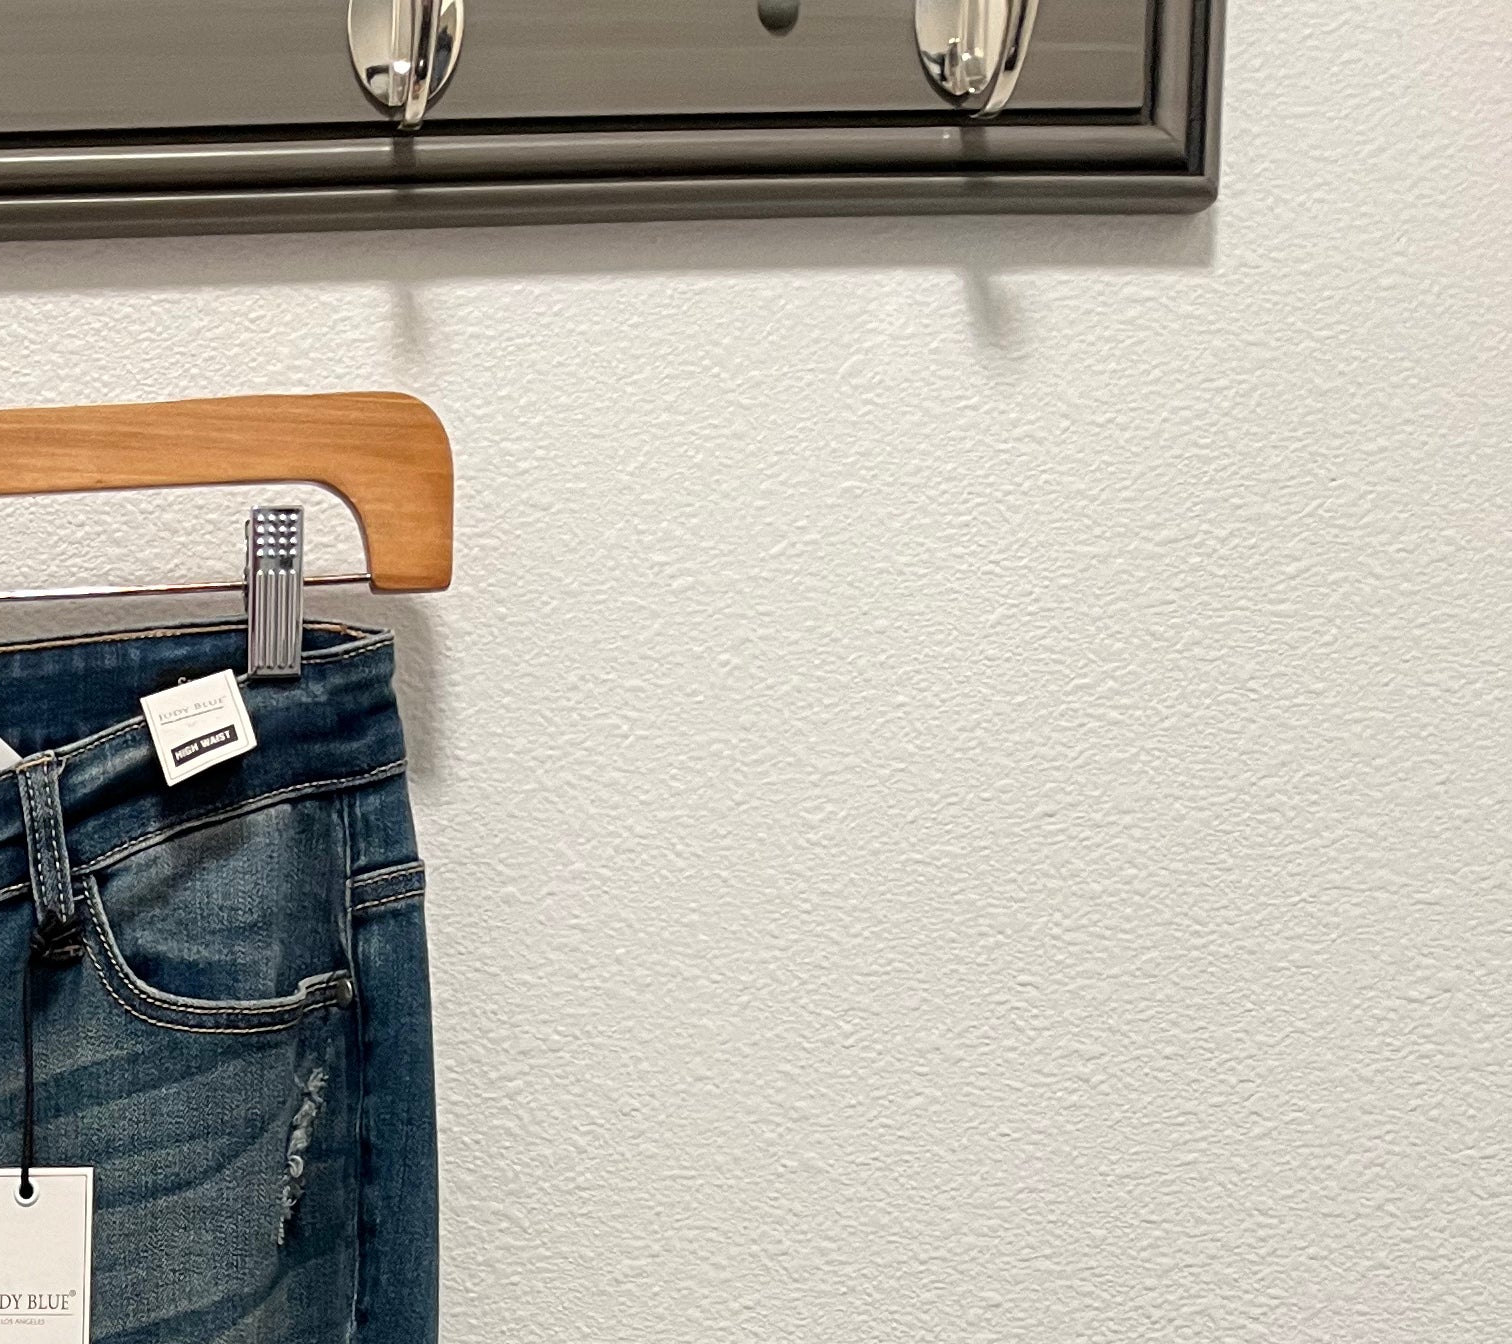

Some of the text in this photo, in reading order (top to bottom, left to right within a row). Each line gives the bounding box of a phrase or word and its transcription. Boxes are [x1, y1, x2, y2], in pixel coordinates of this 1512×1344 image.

[175, 730, 231, 760] HIGH WAIST
[27, 1294, 70, 1310] BLUE
[14, 1318, 46, 1326] ANGELES
